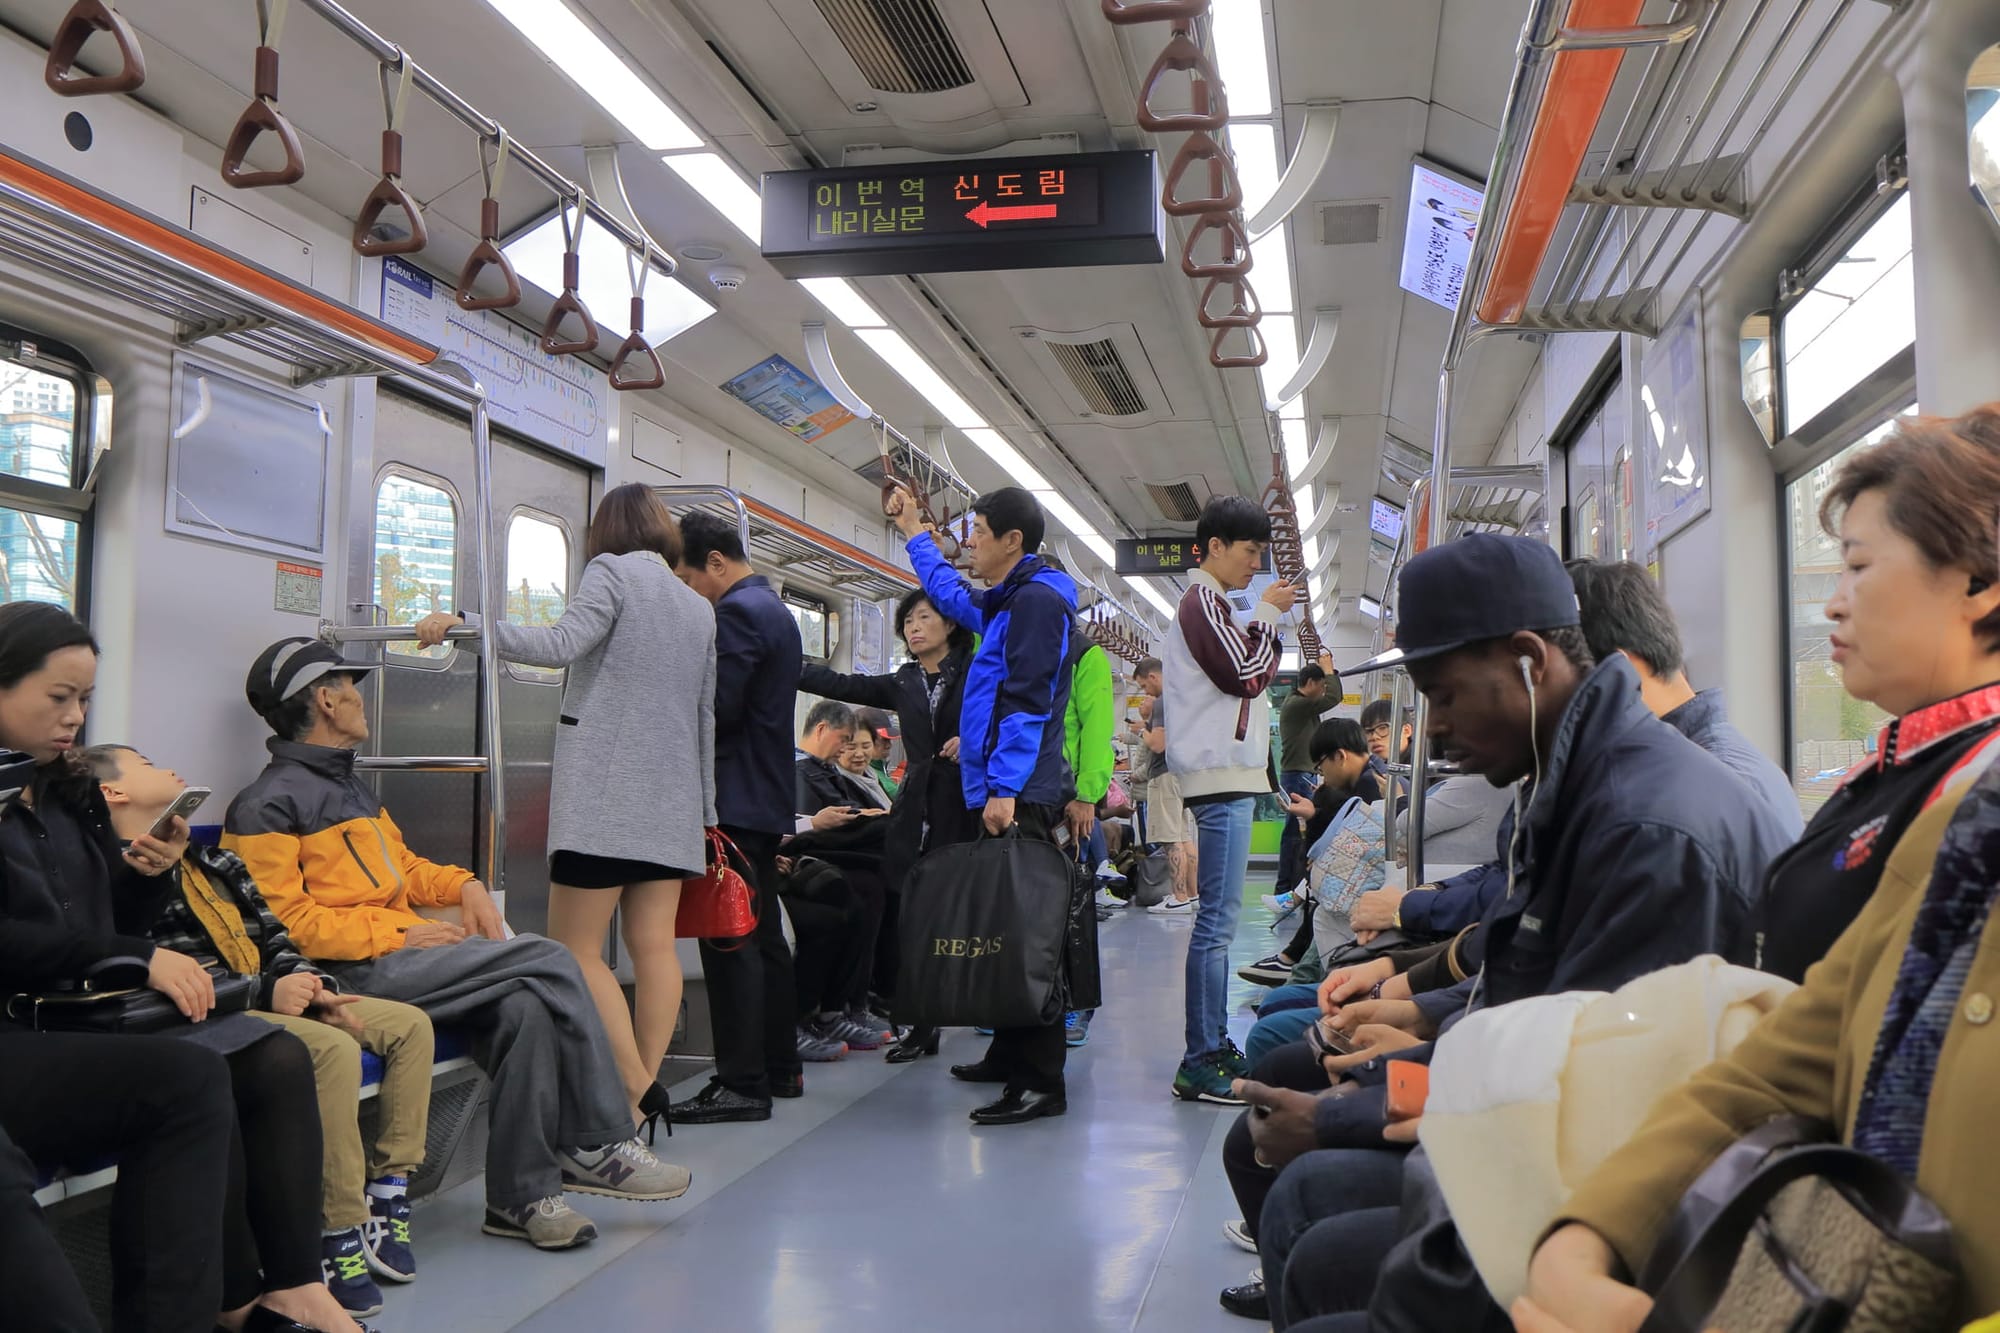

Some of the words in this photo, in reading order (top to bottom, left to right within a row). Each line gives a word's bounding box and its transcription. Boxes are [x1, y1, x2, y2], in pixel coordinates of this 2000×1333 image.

[954, 170, 1065, 200] 신도림
[816, 206, 926, 236] 내리실문
[933, 937, 1002, 958] REGAS
